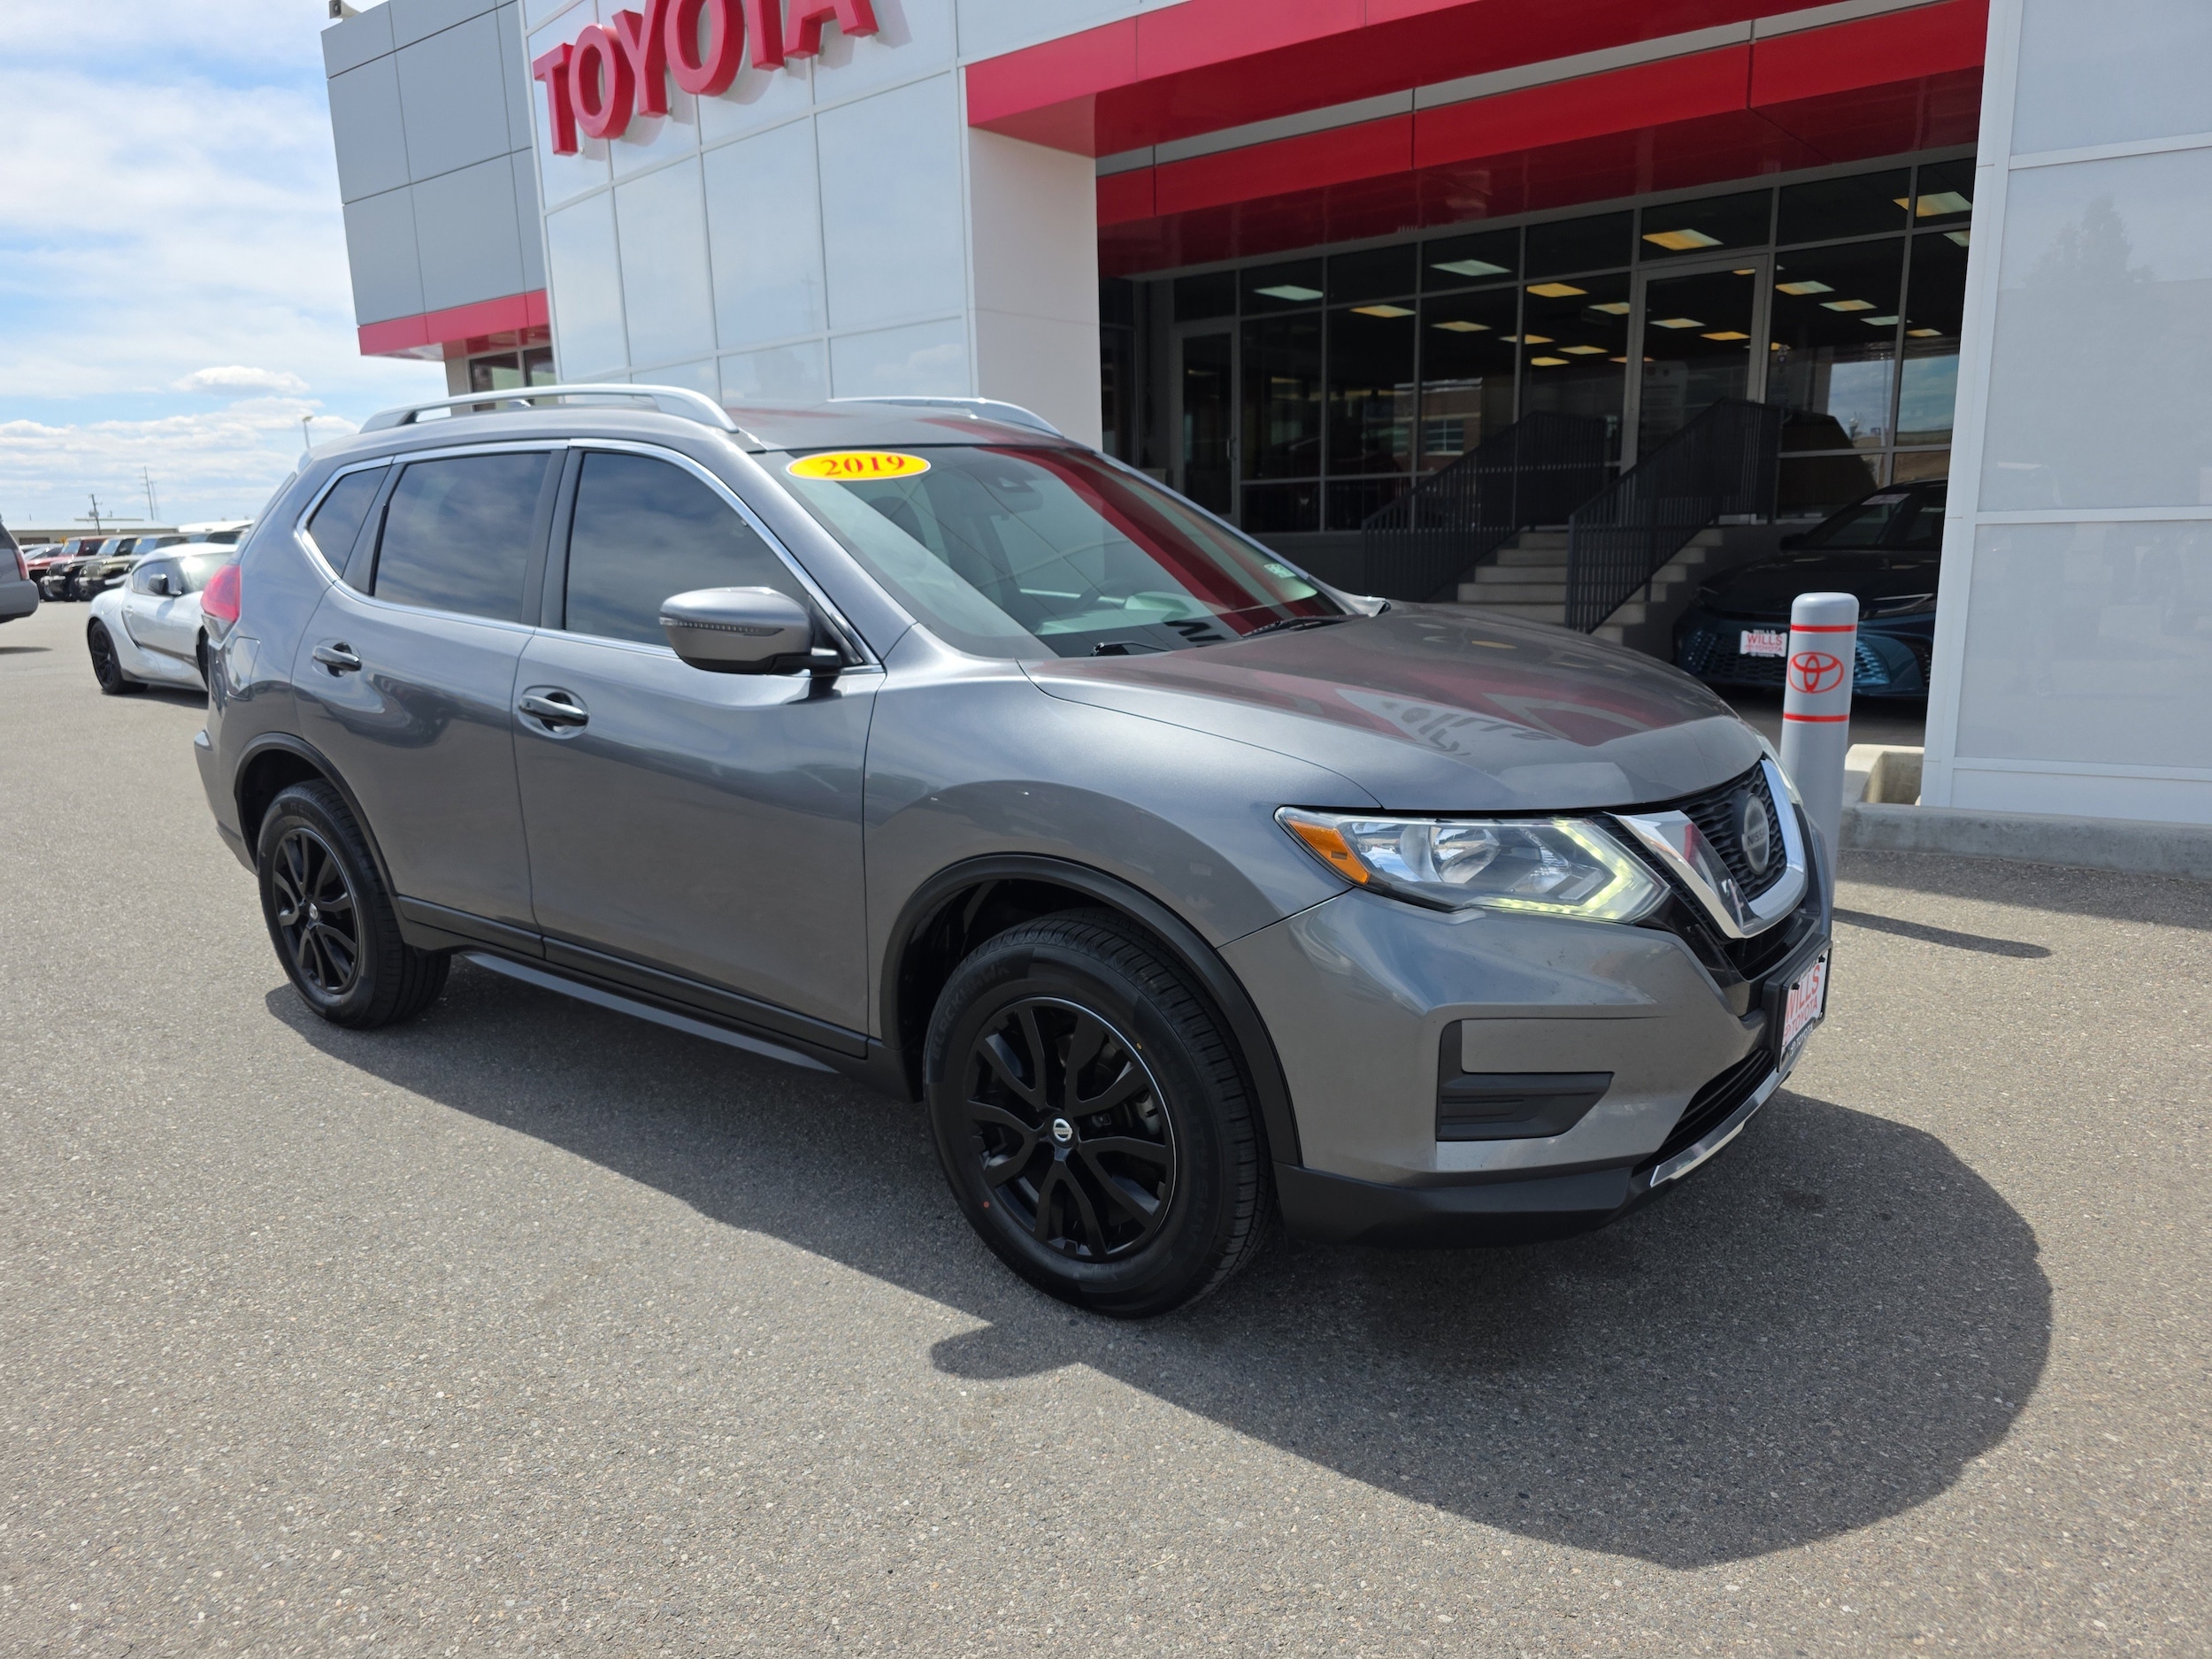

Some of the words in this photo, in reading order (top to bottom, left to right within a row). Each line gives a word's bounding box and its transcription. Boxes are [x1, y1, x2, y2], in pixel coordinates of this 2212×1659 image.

[820, 455, 905, 477] 2019
[1747, 634, 1783, 646] WILLS
[1785, 964, 1821, 1021] WILLS
